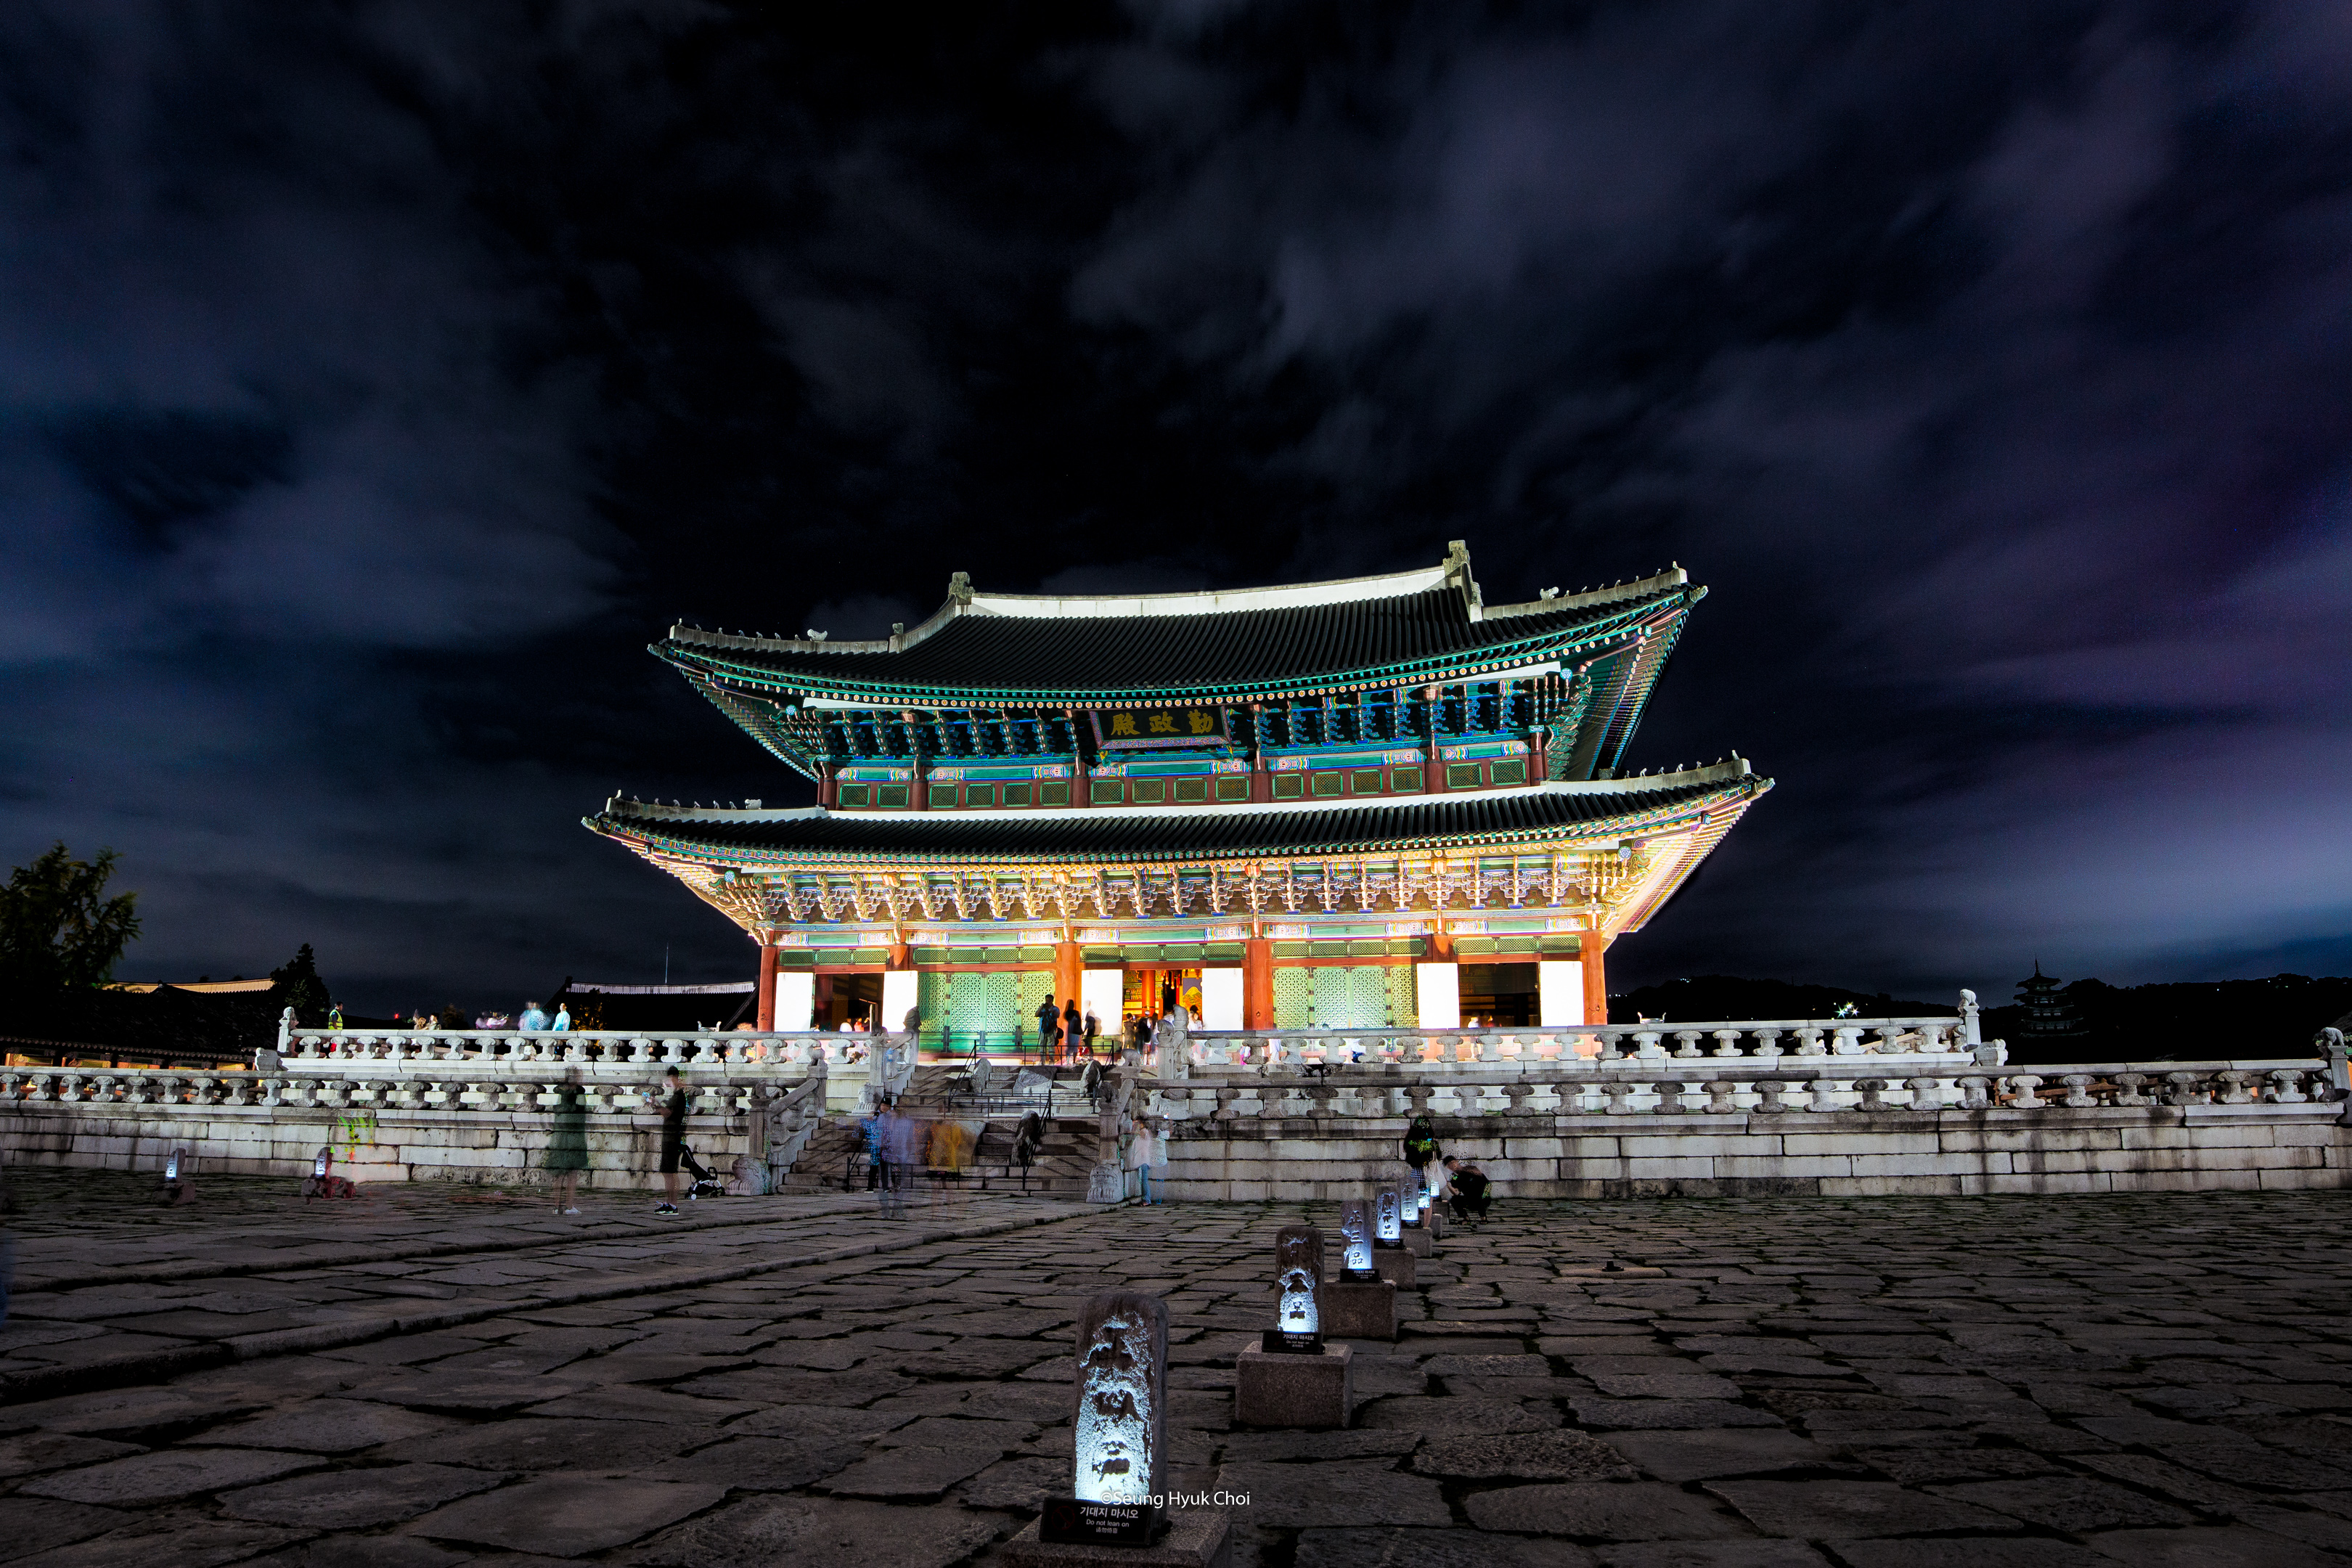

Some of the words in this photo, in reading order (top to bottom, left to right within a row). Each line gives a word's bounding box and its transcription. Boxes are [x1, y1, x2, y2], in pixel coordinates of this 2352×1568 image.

[1349, 1210, 1364, 1265] 正三品
[1079, 1506, 1108, 1518] 기대지
[1111, 1508, 1139, 1519] 마시오
